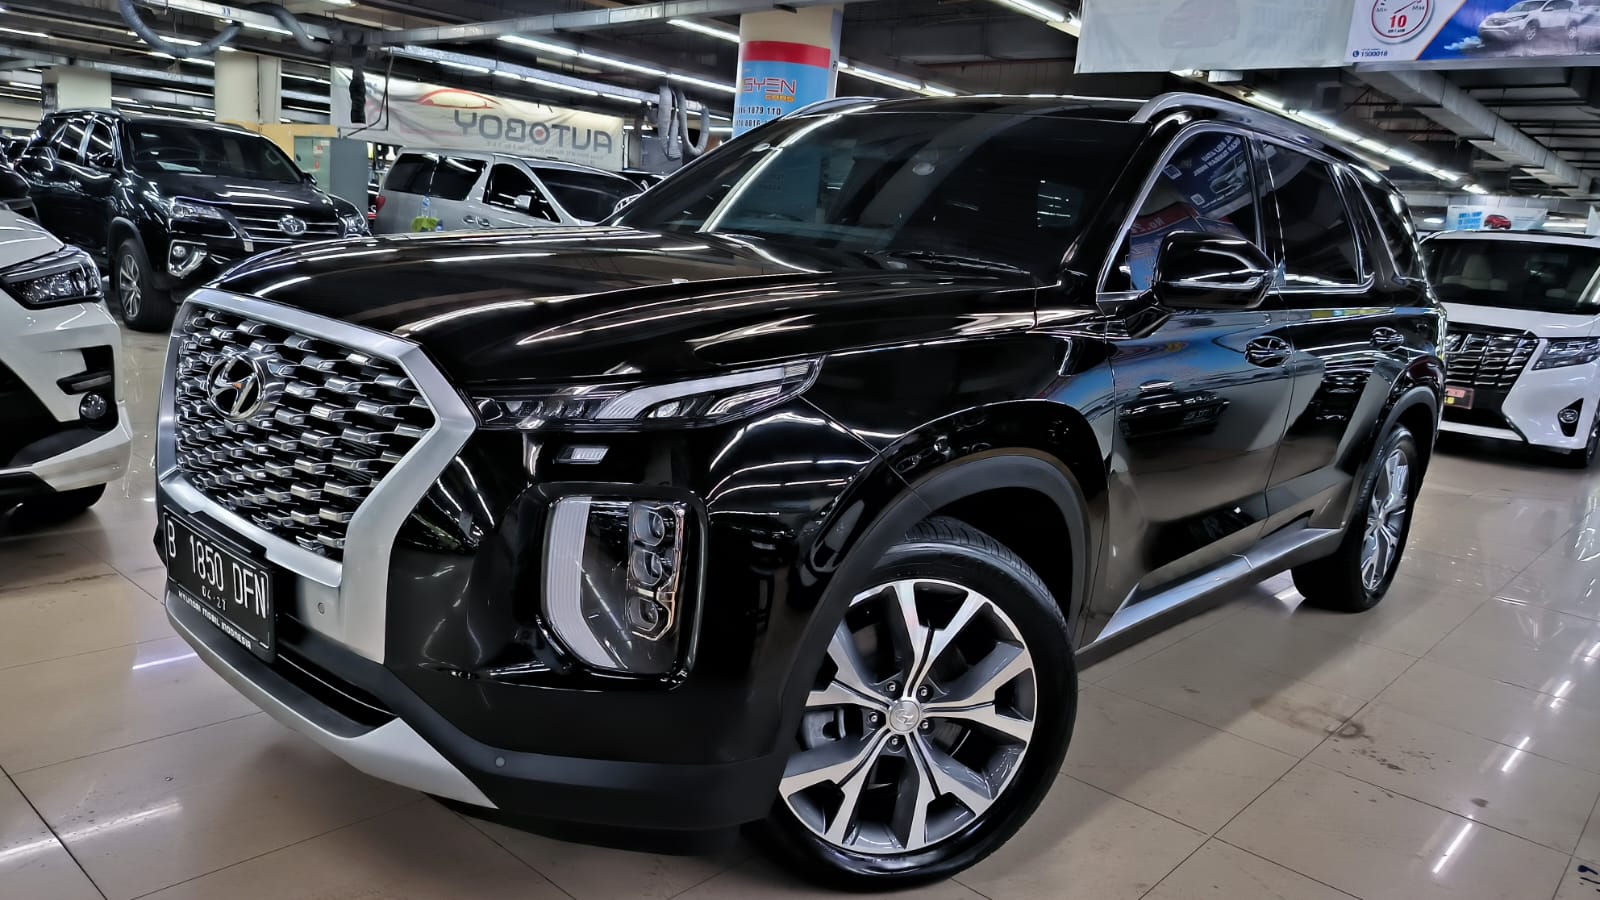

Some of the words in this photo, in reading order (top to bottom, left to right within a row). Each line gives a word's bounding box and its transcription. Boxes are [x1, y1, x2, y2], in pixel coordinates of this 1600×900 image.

[1390, 15, 1407, 28] 10
[767, 107, 781, 115] 110
[167, 519, 176, 558] B
[189, 535, 224, 592] 1850
[232, 562, 267, 619] DFN
